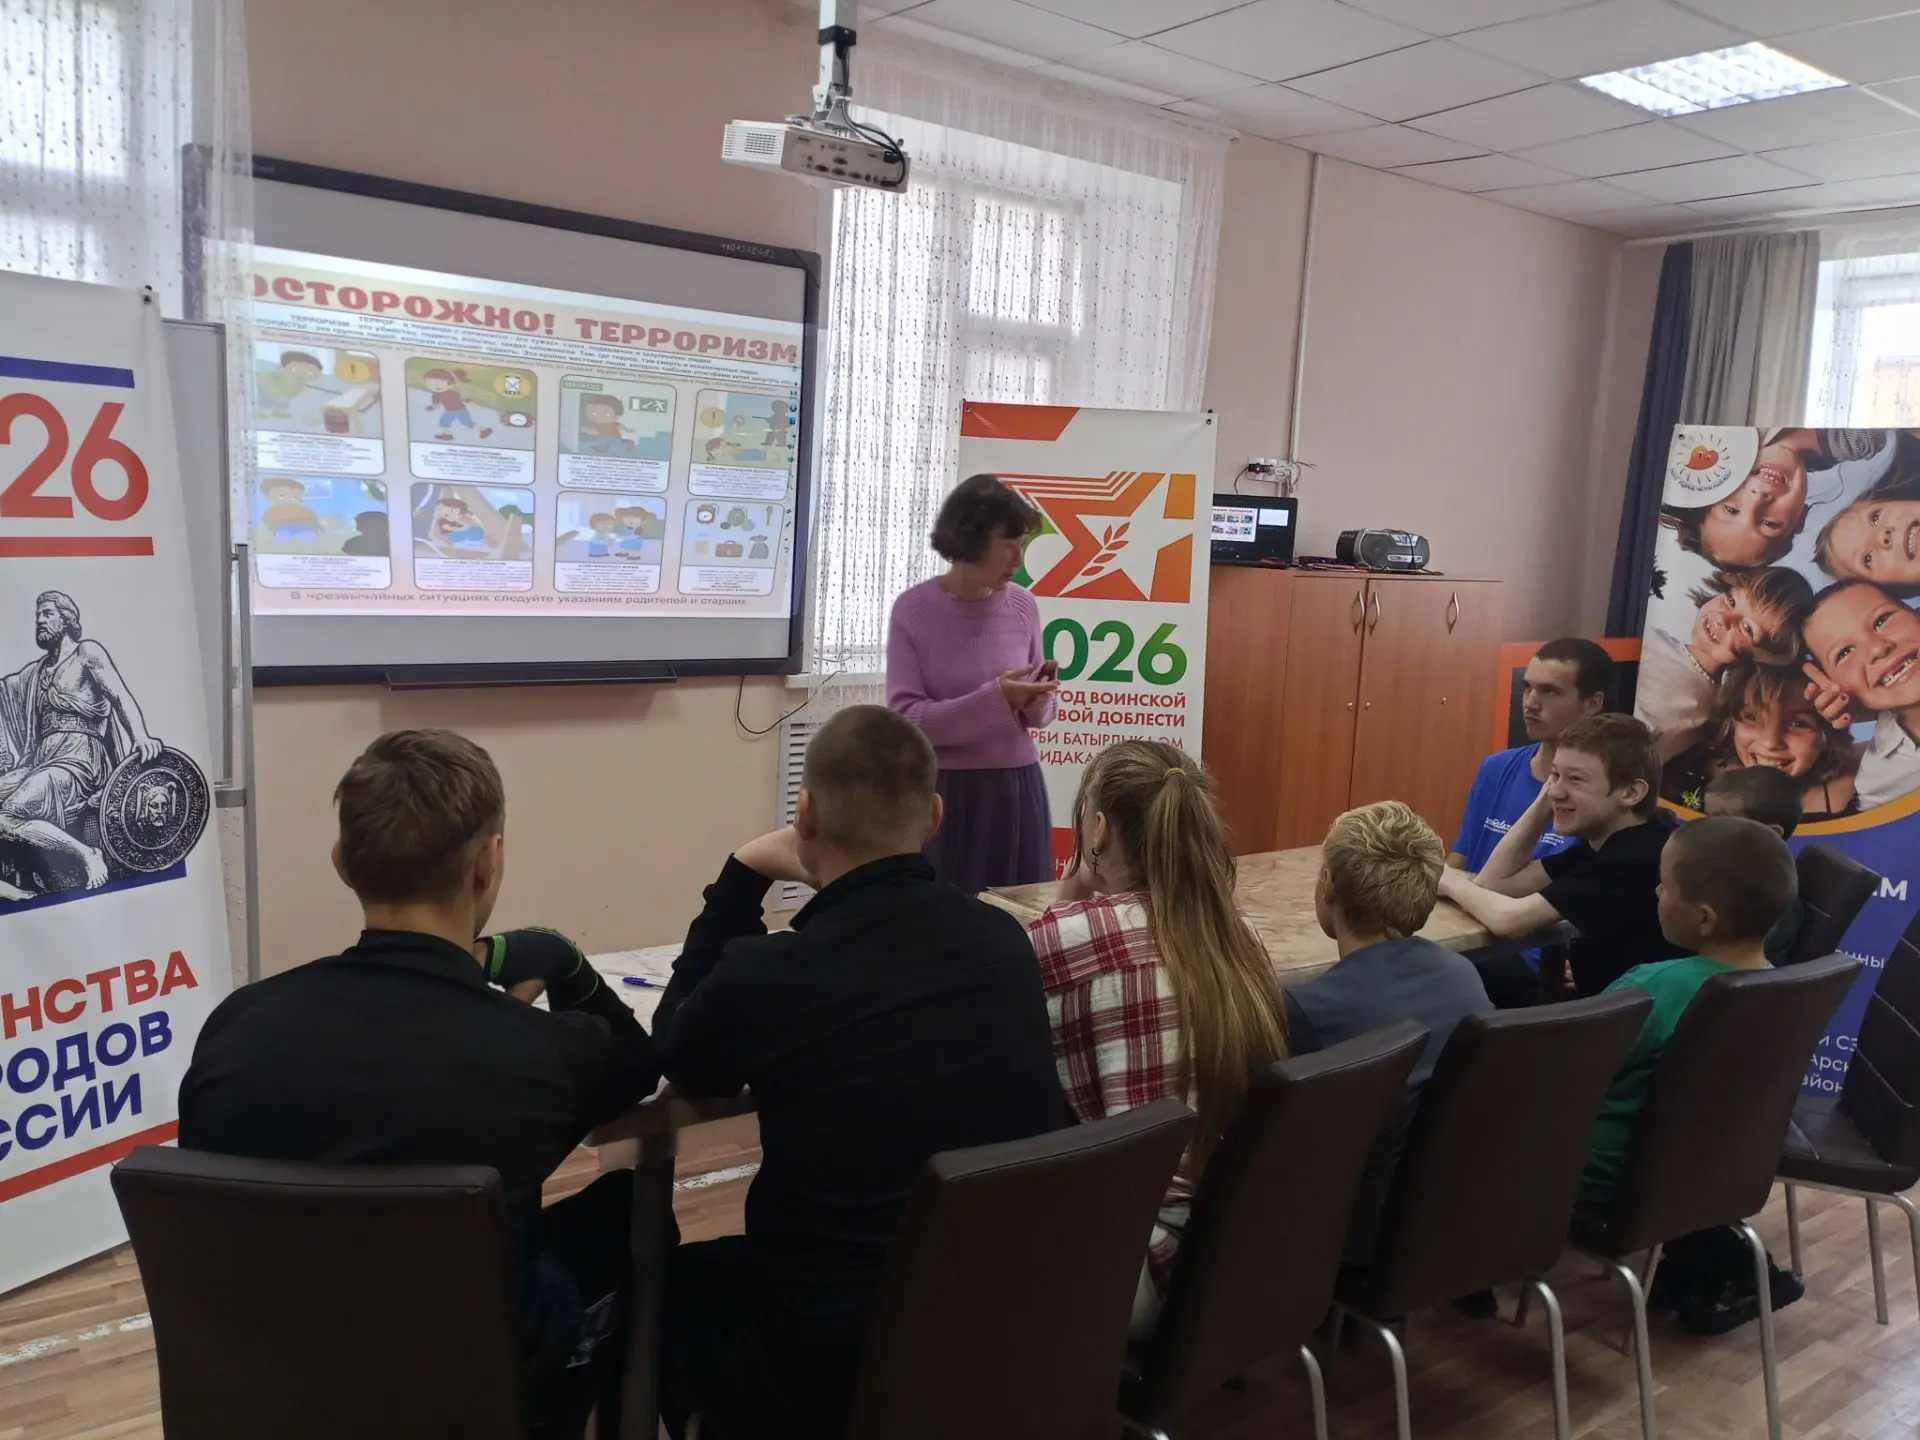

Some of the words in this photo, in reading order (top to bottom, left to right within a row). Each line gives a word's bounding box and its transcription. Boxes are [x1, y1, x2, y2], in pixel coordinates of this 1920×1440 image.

[290, 314, 350, 328] ТЕРРОРИЗМ
[575, 317, 798, 364] ТЕРРОРИЗМ
[0, 393, 149, 521] 26
[419, 592, 490, 603] ситуациях
[493, 593, 554, 604] следуйте
[625, 594, 688, 605] родителей
[1043, 618, 1187, 685] 026
[1058, 707, 1093, 723] ВОЙ
[1097, 711, 1185, 727] ДОБЛЕСТИ
[1090, 691, 1186, 709] ВОИНСКОЙ
[1, 950, 198, 1039] НСТВА
[0, 1011, 172, 1093] ОДОВ
